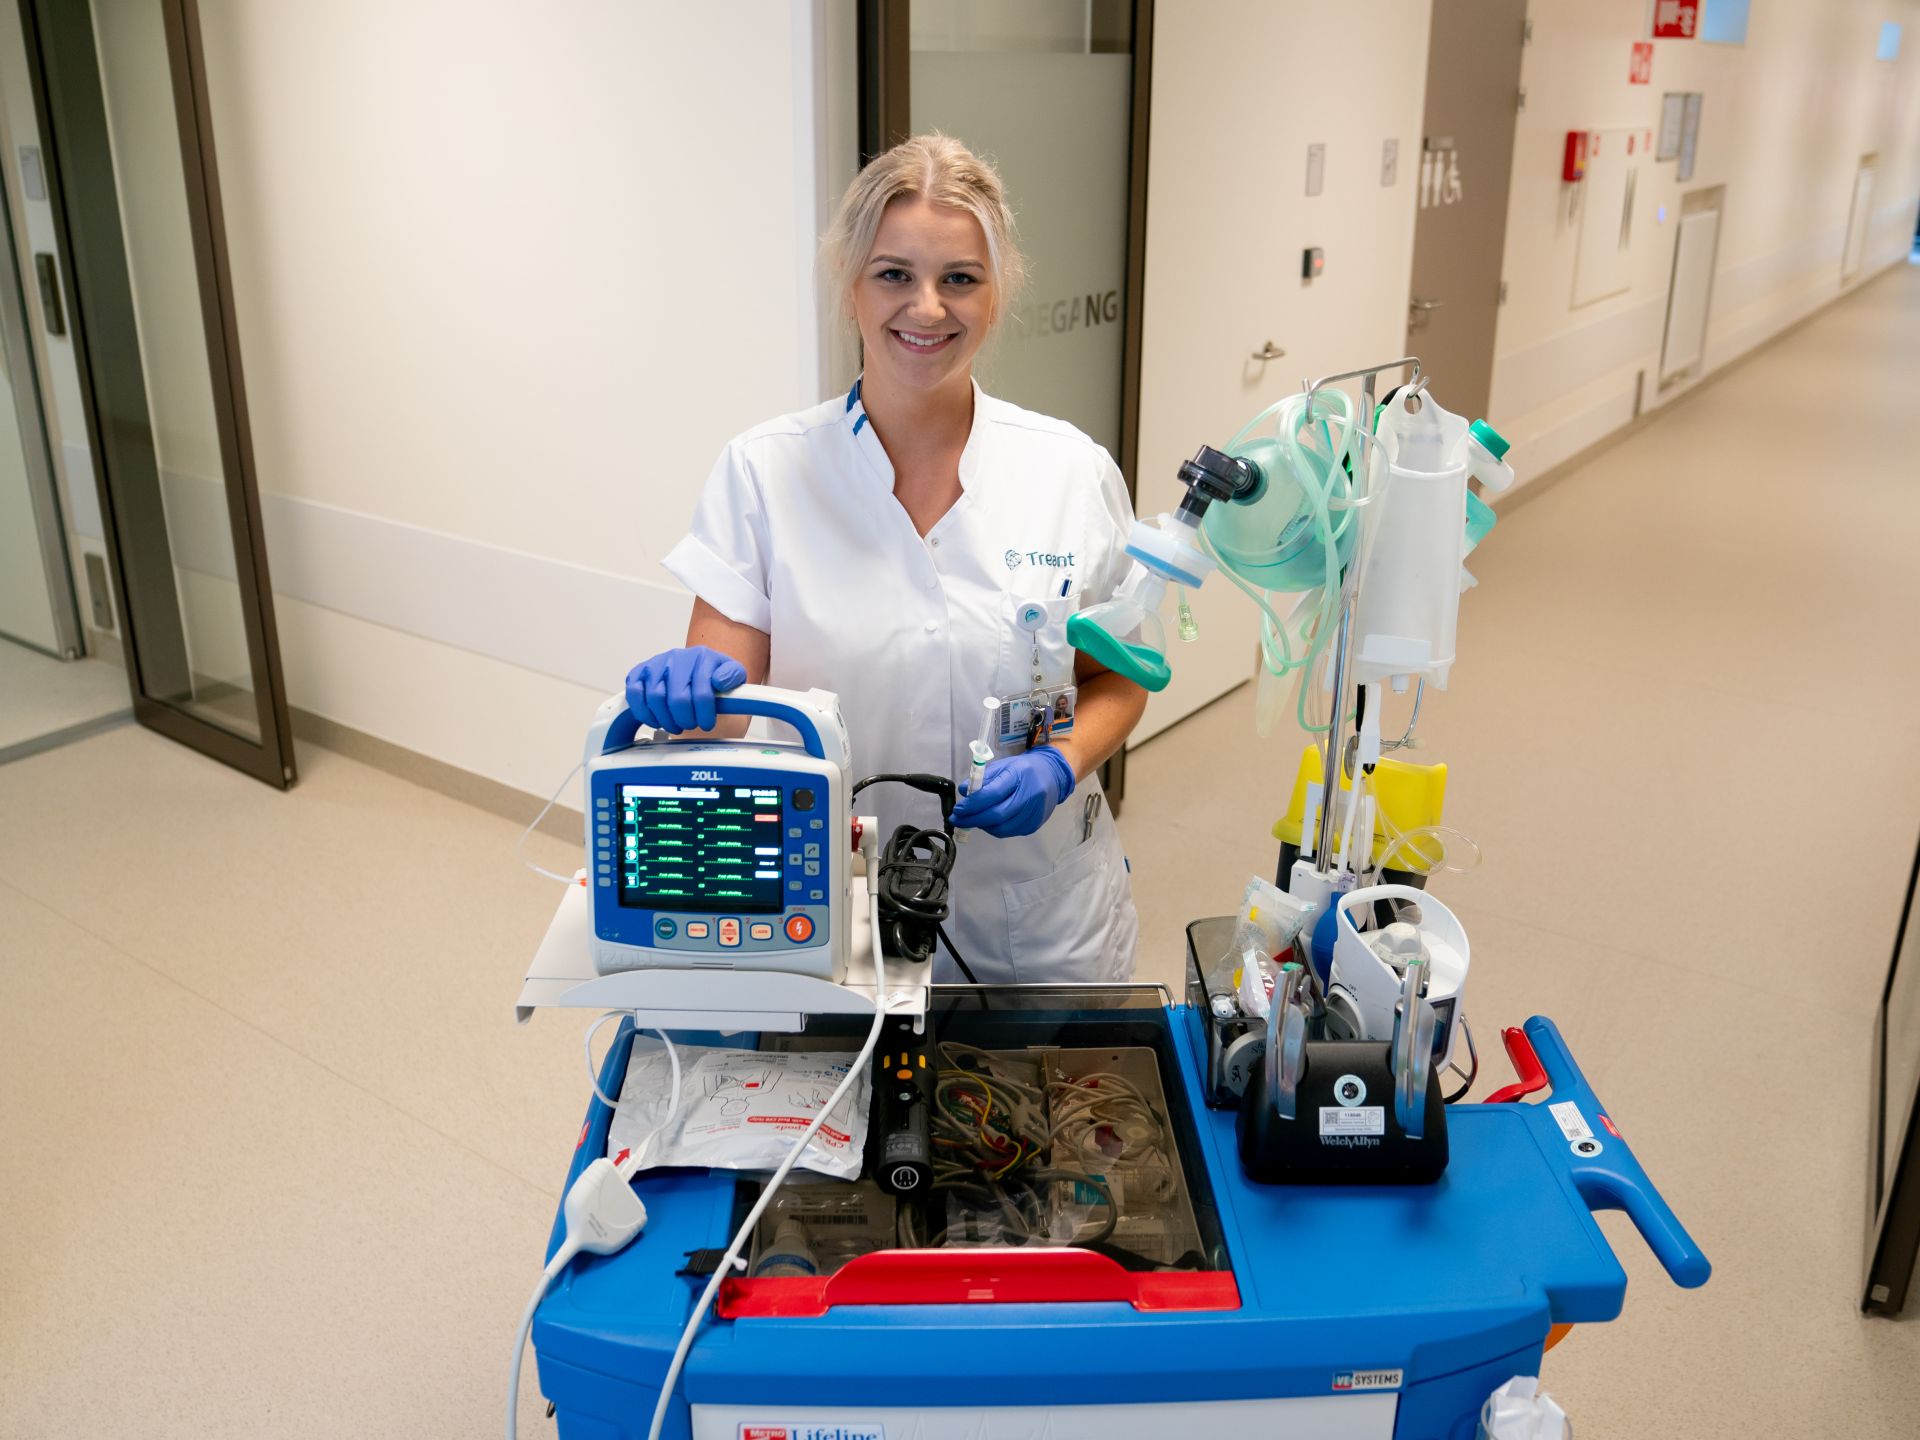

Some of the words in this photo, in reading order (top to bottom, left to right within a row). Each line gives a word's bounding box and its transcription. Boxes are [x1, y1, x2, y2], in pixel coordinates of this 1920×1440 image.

[1026, 551, 1075, 568] Treant
[691, 771, 720, 781] ZOLL
[825, 1138, 844, 1149] CPR
[1354, 1374, 1399, 1386] SYSTEMS
[791, 1428, 878, 1440] Lifeline
